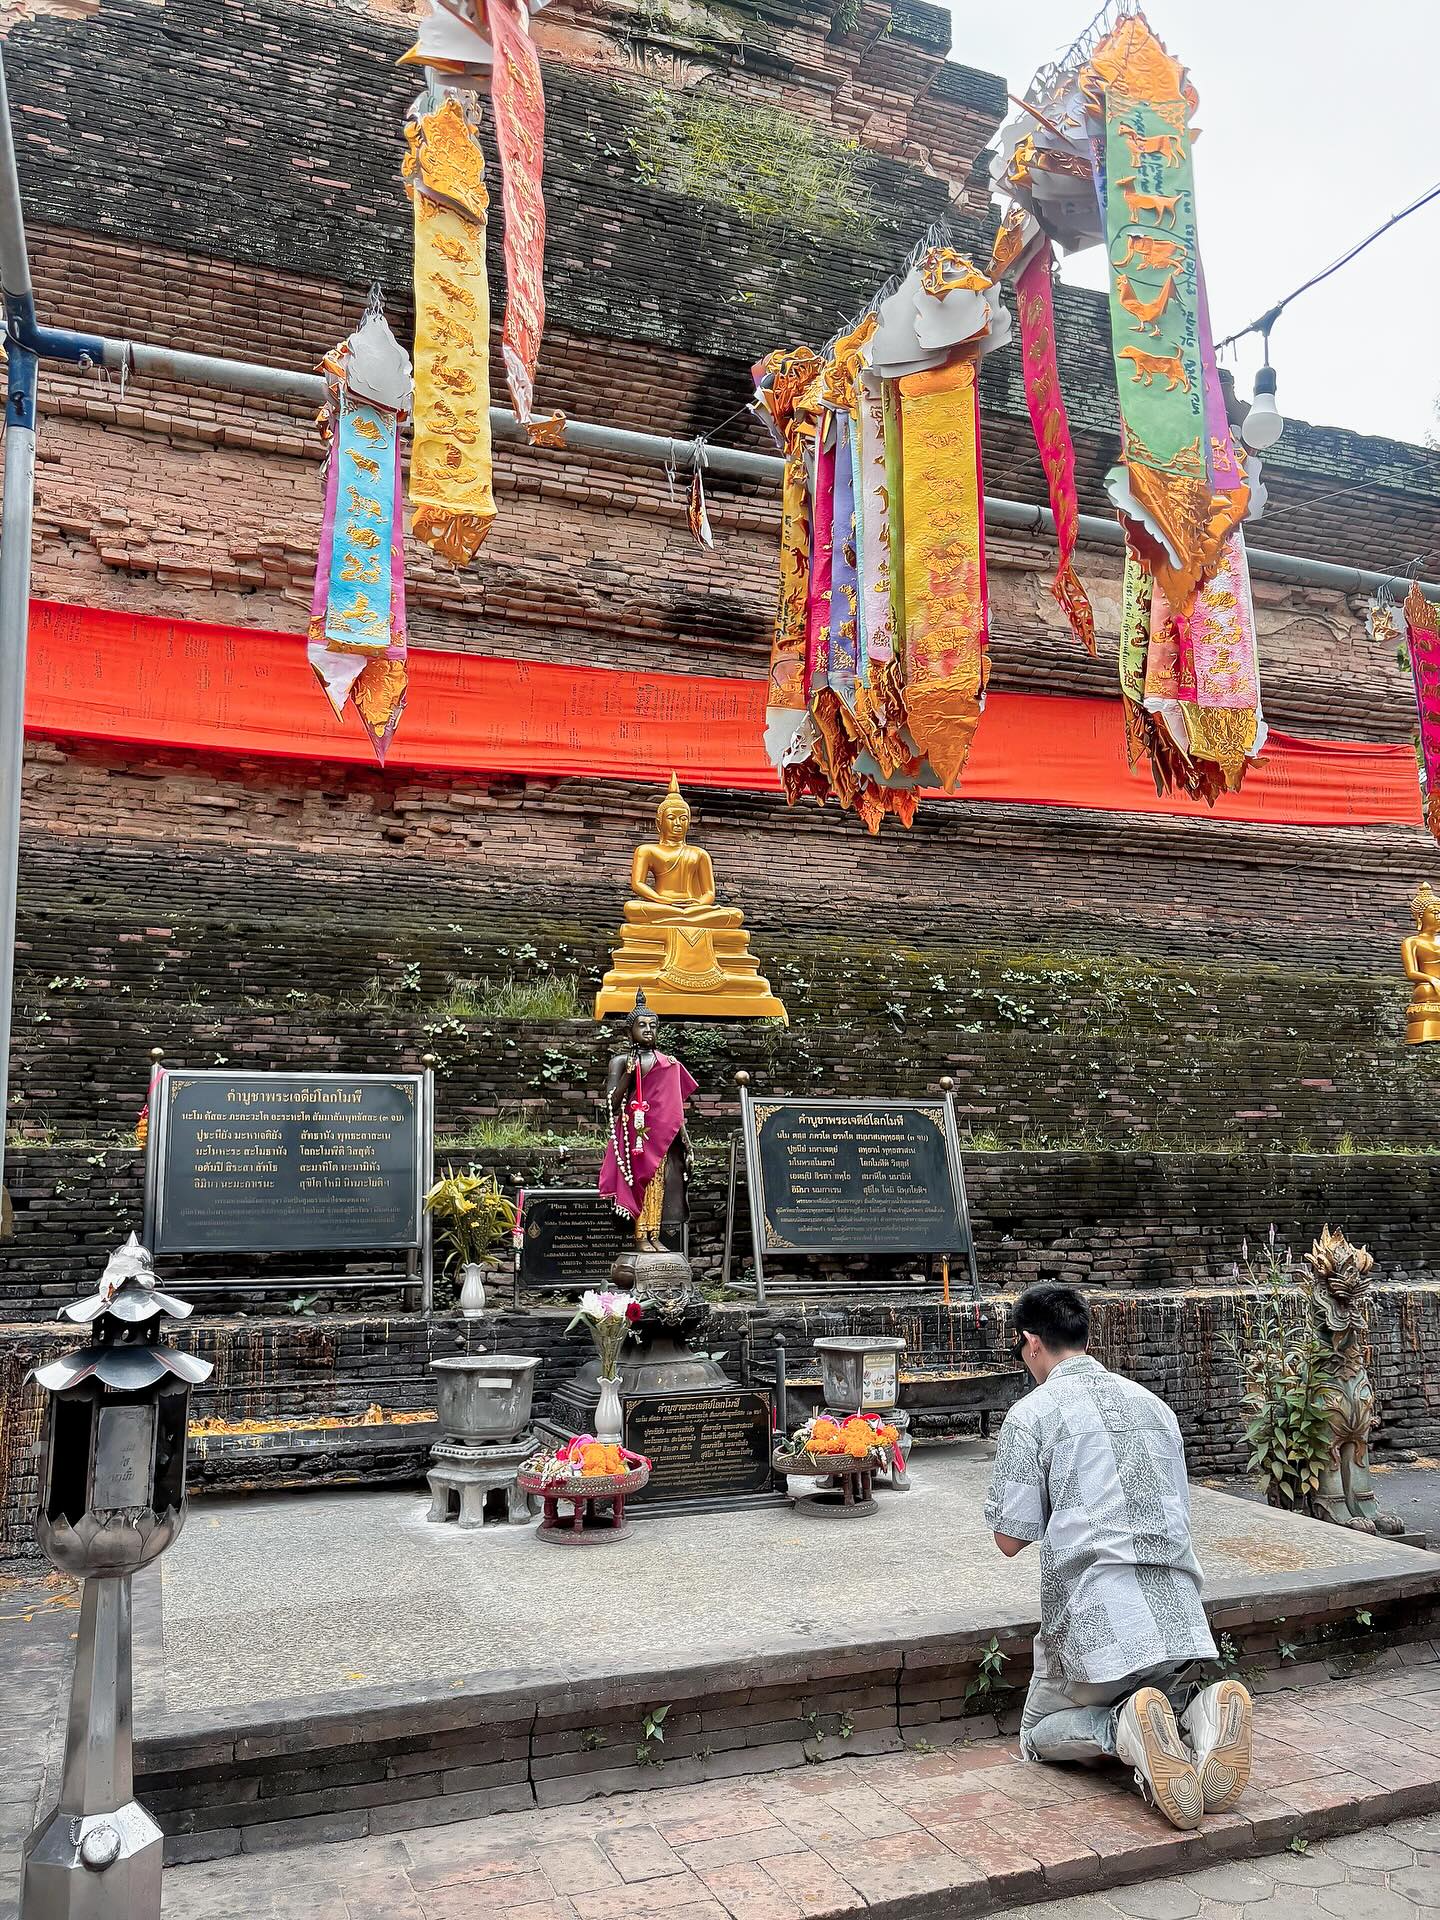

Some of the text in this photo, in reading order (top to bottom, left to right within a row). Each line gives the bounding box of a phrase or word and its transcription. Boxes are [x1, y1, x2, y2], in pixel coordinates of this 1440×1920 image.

[799, 1113, 903, 1128] คำบูชาพระเจดีย์โลกโมฬี
